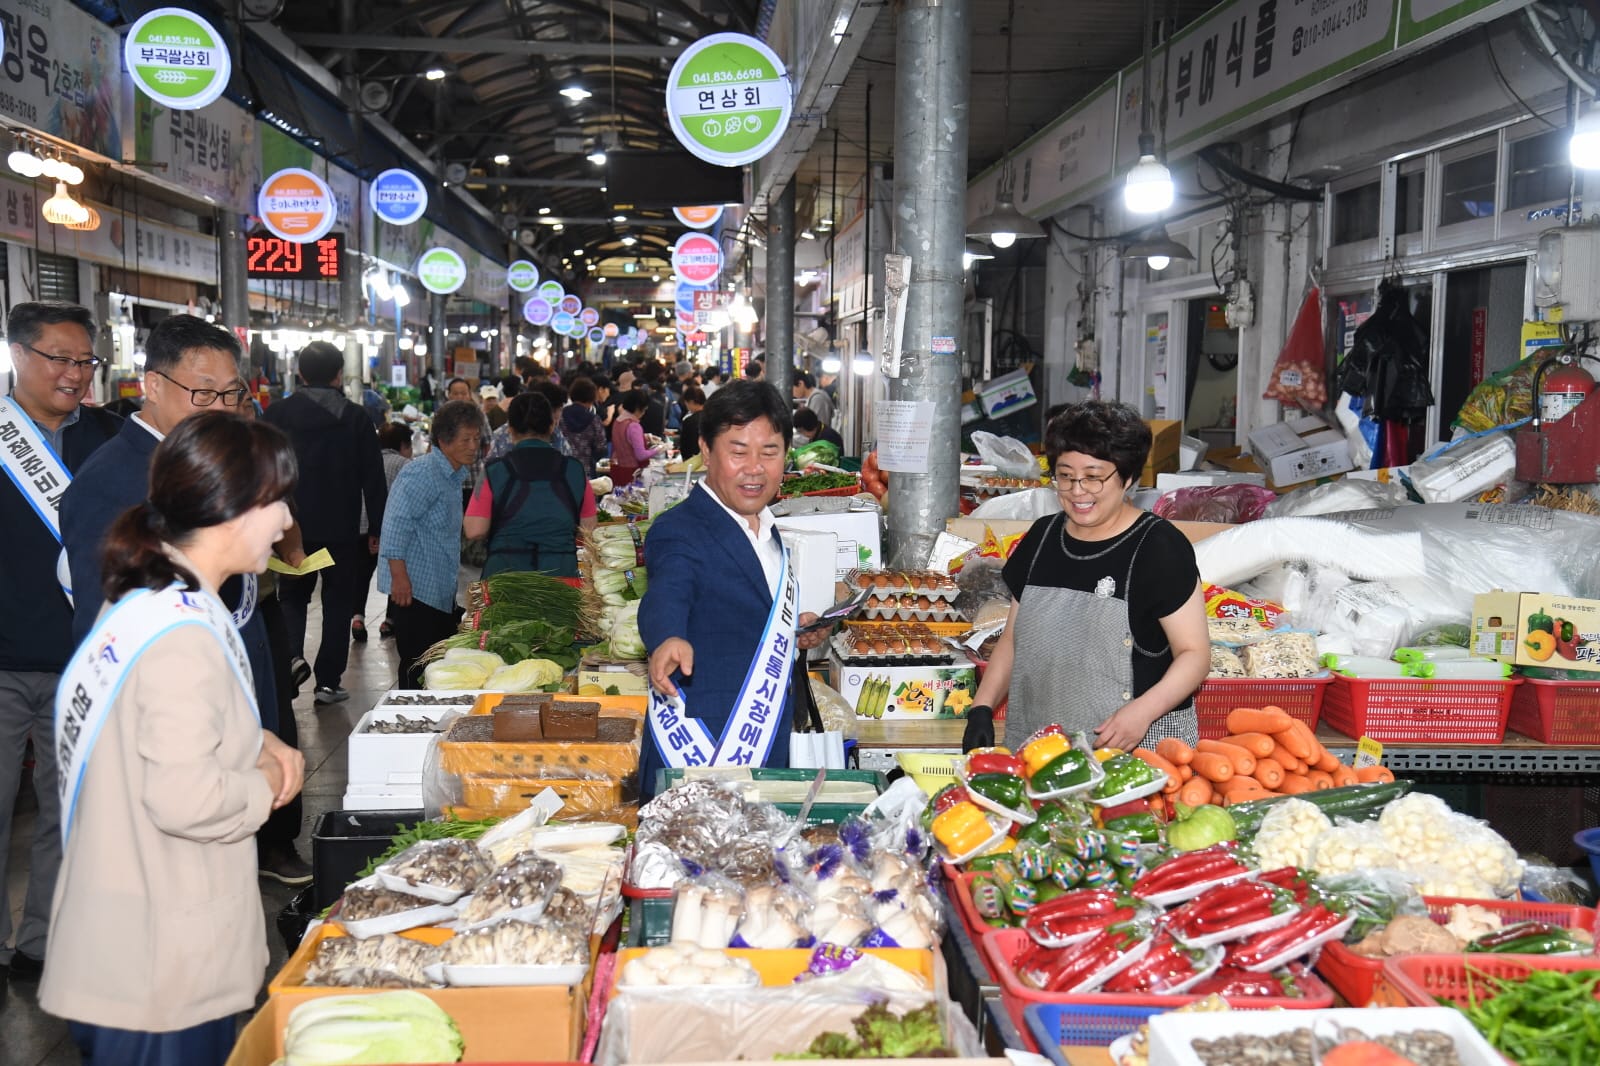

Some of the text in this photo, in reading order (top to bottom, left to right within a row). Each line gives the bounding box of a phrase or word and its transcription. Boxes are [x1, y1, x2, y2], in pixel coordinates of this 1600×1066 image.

[140, 47, 211, 66] 부곡쌀상회
[693, 68, 762, 84] 041.836.6698
[698, 86, 761, 111] 연상회
